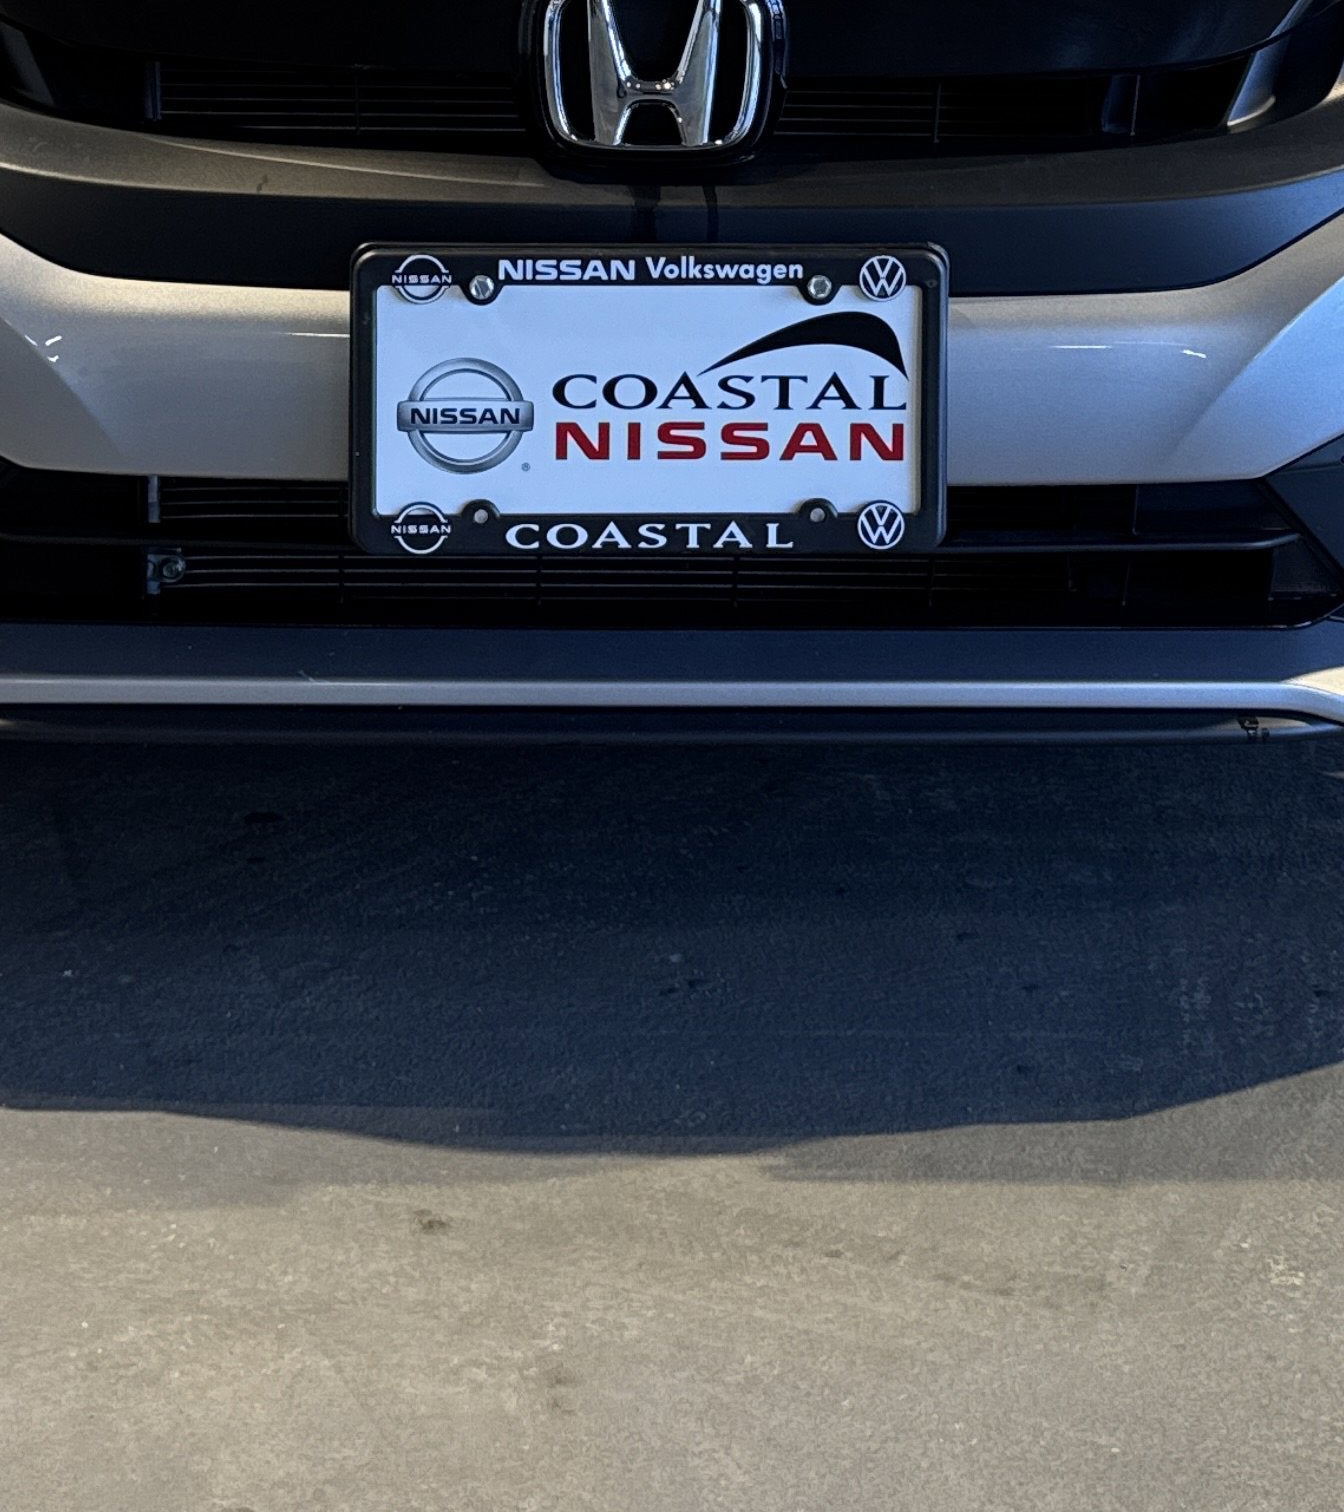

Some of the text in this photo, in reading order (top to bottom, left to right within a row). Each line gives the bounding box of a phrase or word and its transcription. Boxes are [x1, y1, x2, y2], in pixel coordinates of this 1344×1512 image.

[391, 274, 453, 284] NISSAN
[497, 255, 803, 284] NISSAN Volkswagen
[552, 371, 907, 411] COASTAL
[411, 407, 521, 426] NISSAN
[555, 422, 905, 461] NISSAN
[390, 524, 452, 534] NISSAN
[505, 520, 794, 550] COASTAL
